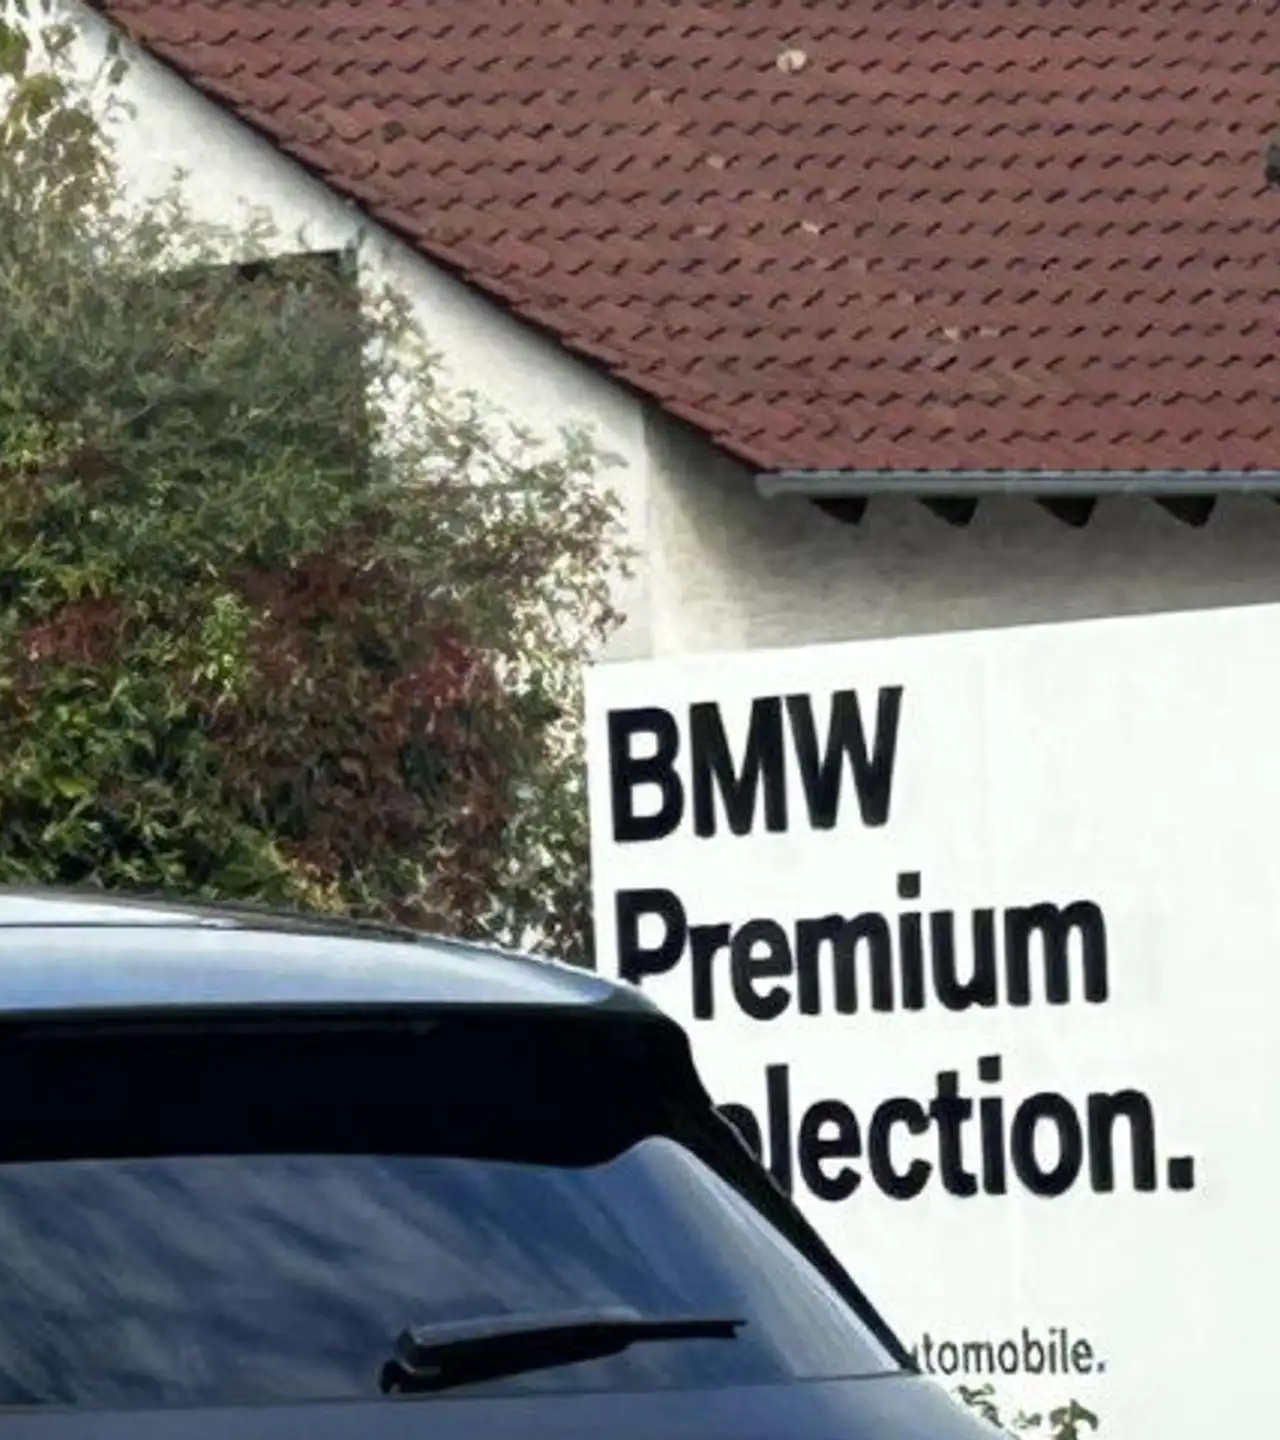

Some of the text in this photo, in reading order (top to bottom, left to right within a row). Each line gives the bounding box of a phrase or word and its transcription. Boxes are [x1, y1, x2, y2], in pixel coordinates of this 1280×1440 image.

[607, 684, 904, 842] BMW
[614, 870, 1109, 1022] Premium
[713, 1054, 1195, 1201] lection.
[913, 1325, 1105, 1376] tomobile.
